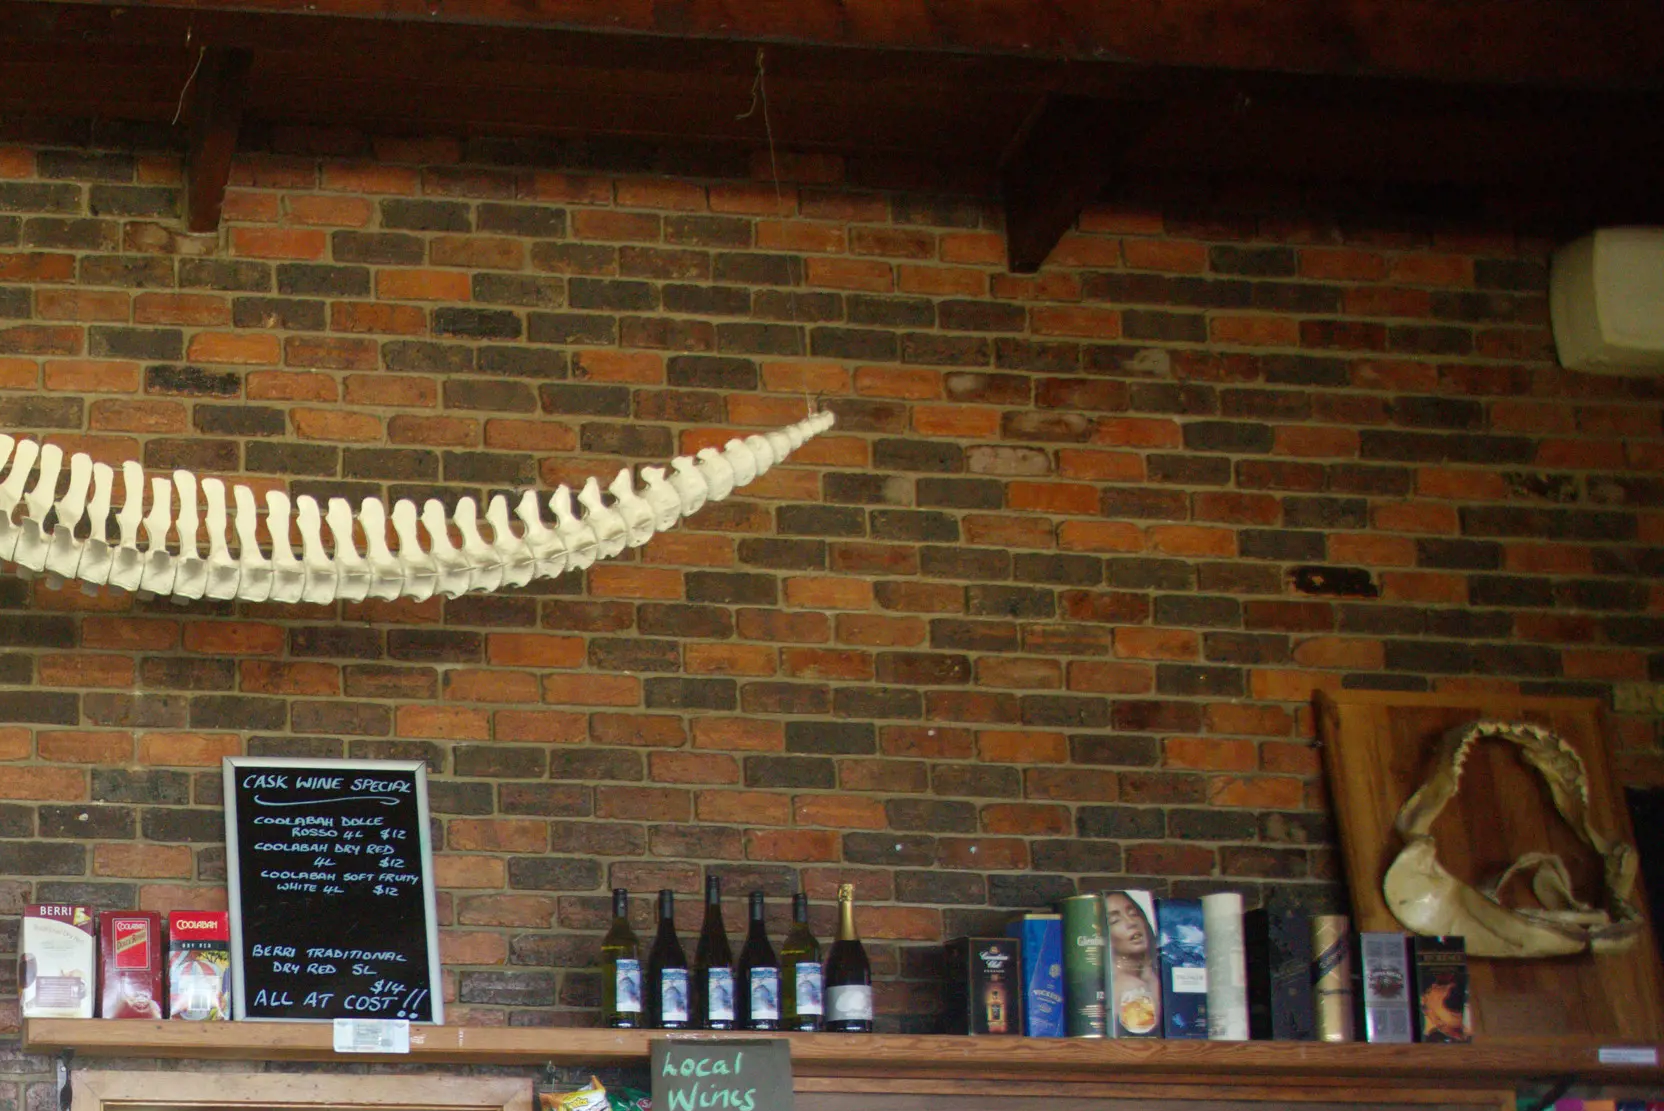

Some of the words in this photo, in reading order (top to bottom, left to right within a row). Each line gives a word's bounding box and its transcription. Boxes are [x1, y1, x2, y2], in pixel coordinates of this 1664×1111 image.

[243, 775, 288, 790] CASK
[296, 776, 344, 790] WINE
[350, 778, 412, 793] SPECIAL
[254, 816, 334, 827] COOLABAH
[341, 816, 384, 826] DOLCE
[292, 828, 337, 838] ROSSO
[343, 831, 363, 840] 4L
[380, 828, 407, 840] $12
[254, 843, 328, 853] COOLABAH
[335, 843, 361, 855] DRY
[366, 844, 394, 855] RED
[314, 857, 336, 867] 4L
[379, 856, 405, 868] $12
[260, 871, 336, 881] COOLABAH
[343, 873, 373, 882] SOFT
[378, 872, 419, 886] FRUITY
[277, 883, 317, 893] WHITE
[323, 885, 345, 894] 4L
[373, 885, 399, 897] $12
[40, 906, 72, 916] BERRI
[176, 919, 218, 930] COOLABAH
[252, 944, 296, 957] BERRI
[306, 948, 408, 962] TRADITIONAL
[273, 962, 299, 974] DRY
[307, 962, 336, 974] RED
[370, 979, 407, 995] $14
[254, 989, 293, 1006] ALL
[303, 992, 335, 1008] AT
[662, 1051, 744, 1078] Local
